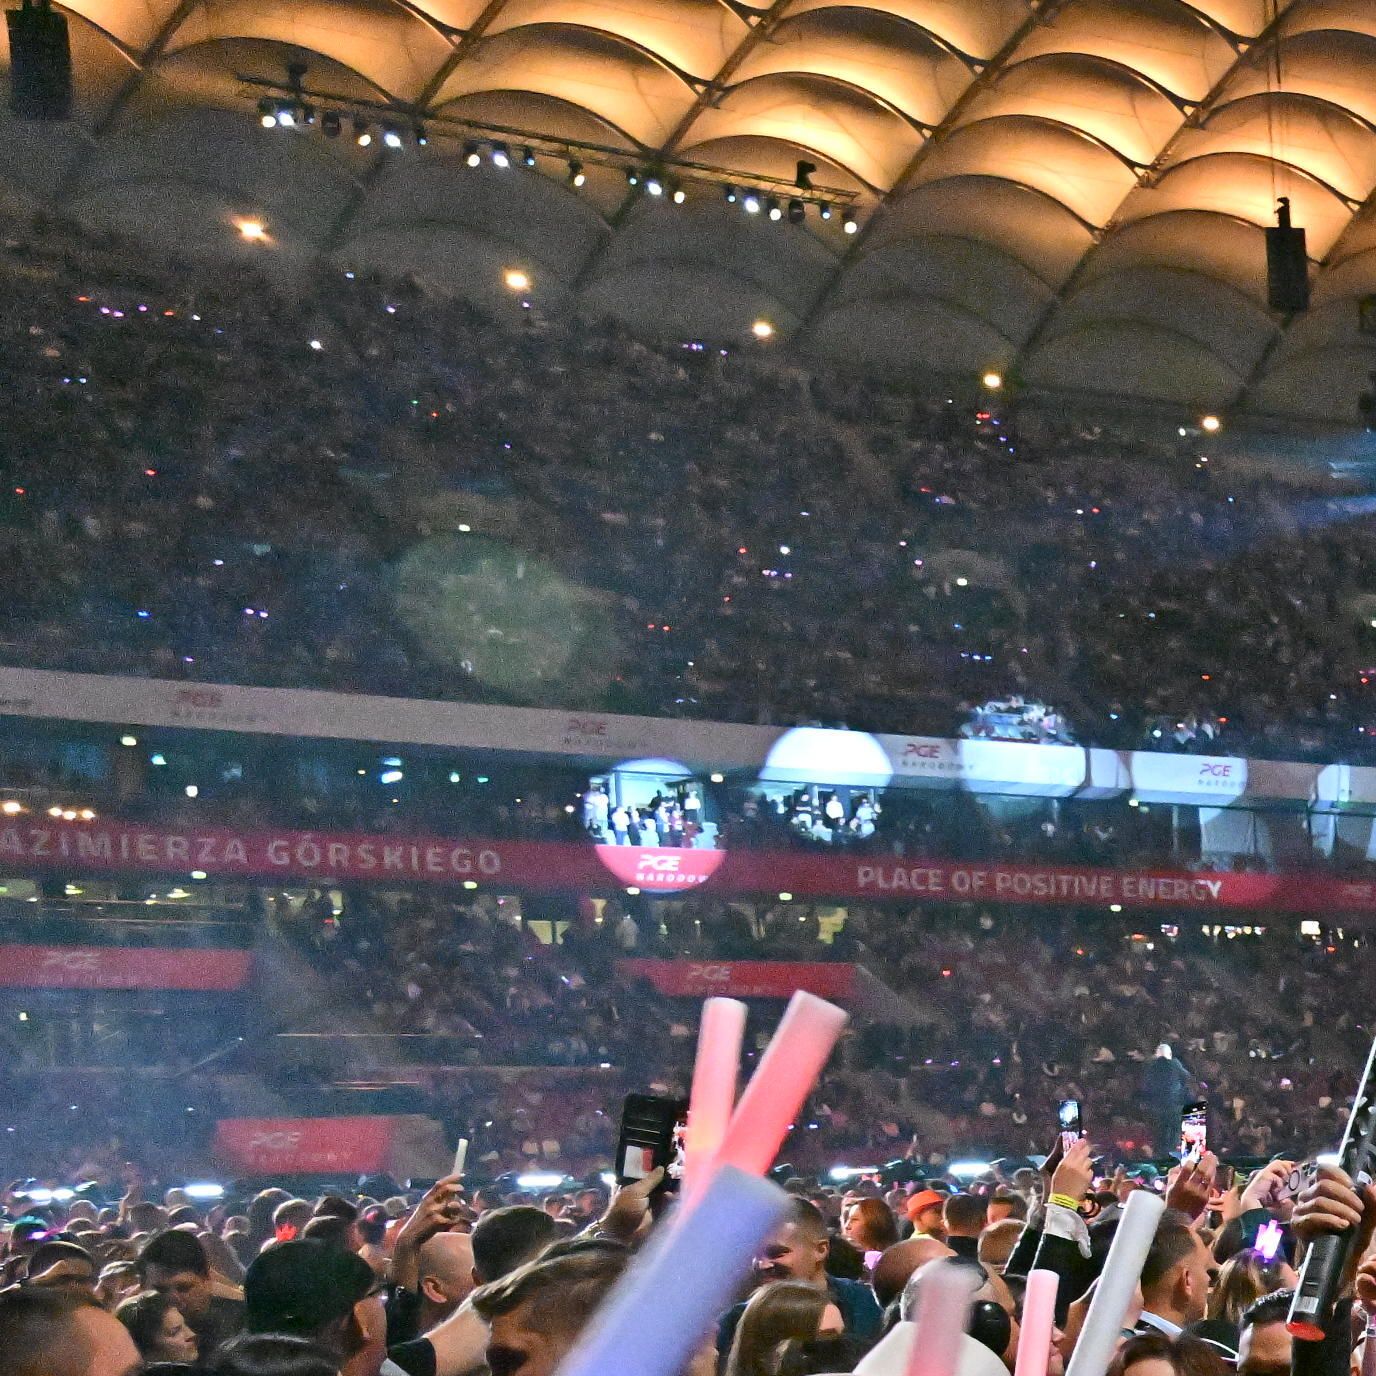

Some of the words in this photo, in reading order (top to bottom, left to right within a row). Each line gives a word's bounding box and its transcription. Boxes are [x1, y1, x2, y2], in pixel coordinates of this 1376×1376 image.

[905, 743, 940, 758] PGE
[1200, 763, 1232, 777] PGE
[267, 832, 502, 874] GÓRSKIEGO
[637, 853, 682, 872] PGE
[857, 865, 944, 891] PLACE
[951, 869, 988, 893] OF
[995, 871, 1113, 898] POSITIVE
[1123, 877, 1222, 900] ENERGY
